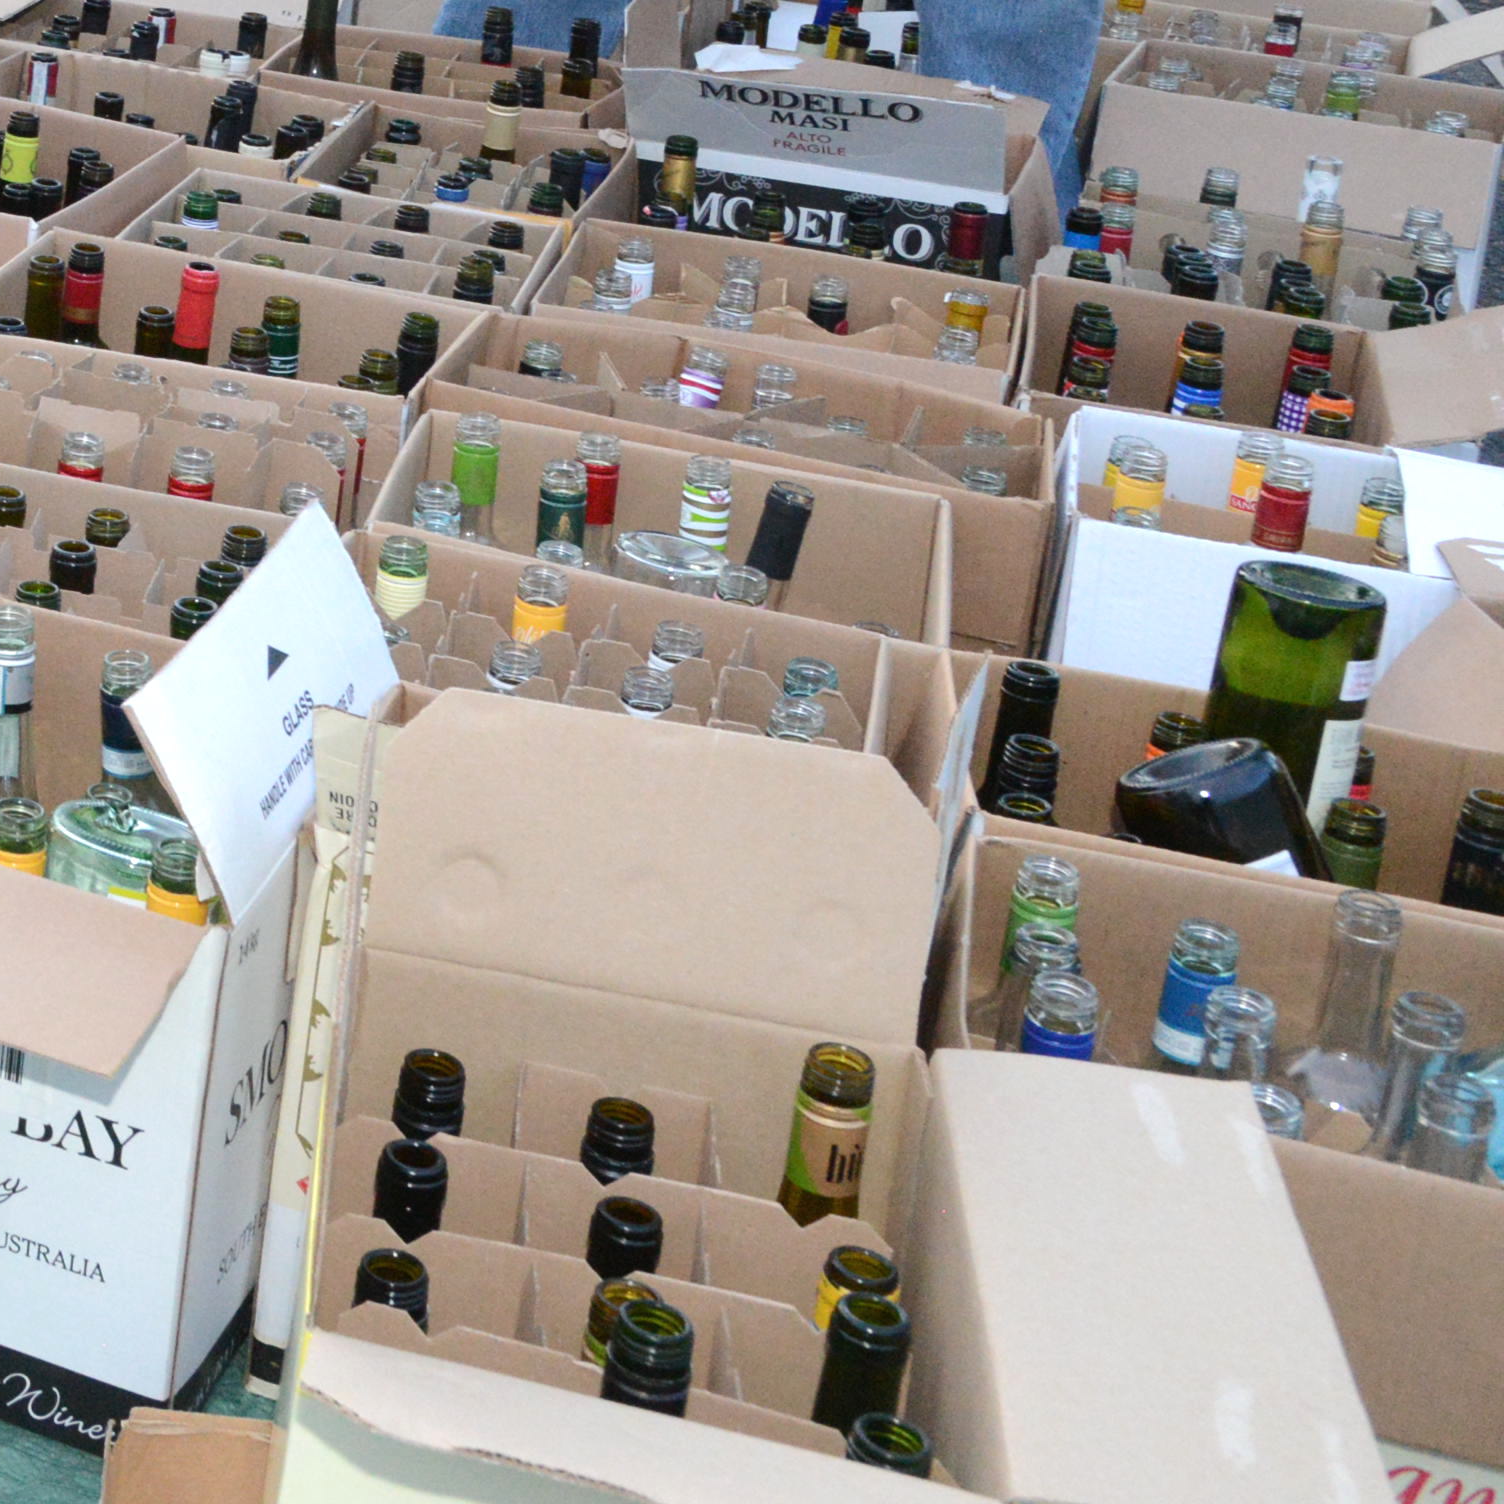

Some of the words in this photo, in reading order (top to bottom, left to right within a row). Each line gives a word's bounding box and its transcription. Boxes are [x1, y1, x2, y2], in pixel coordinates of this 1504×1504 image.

[697, 79, 923, 123] MODELLO
[769, 110, 851, 132] MASI
[772, 138, 847, 157] FRAGILE
[786, 132, 832, 144] ALTO
[282, 689, 314, 736] GLASS
[258, 775, 287, 821] HANDLE
[286, 757, 303, 787] WITH
